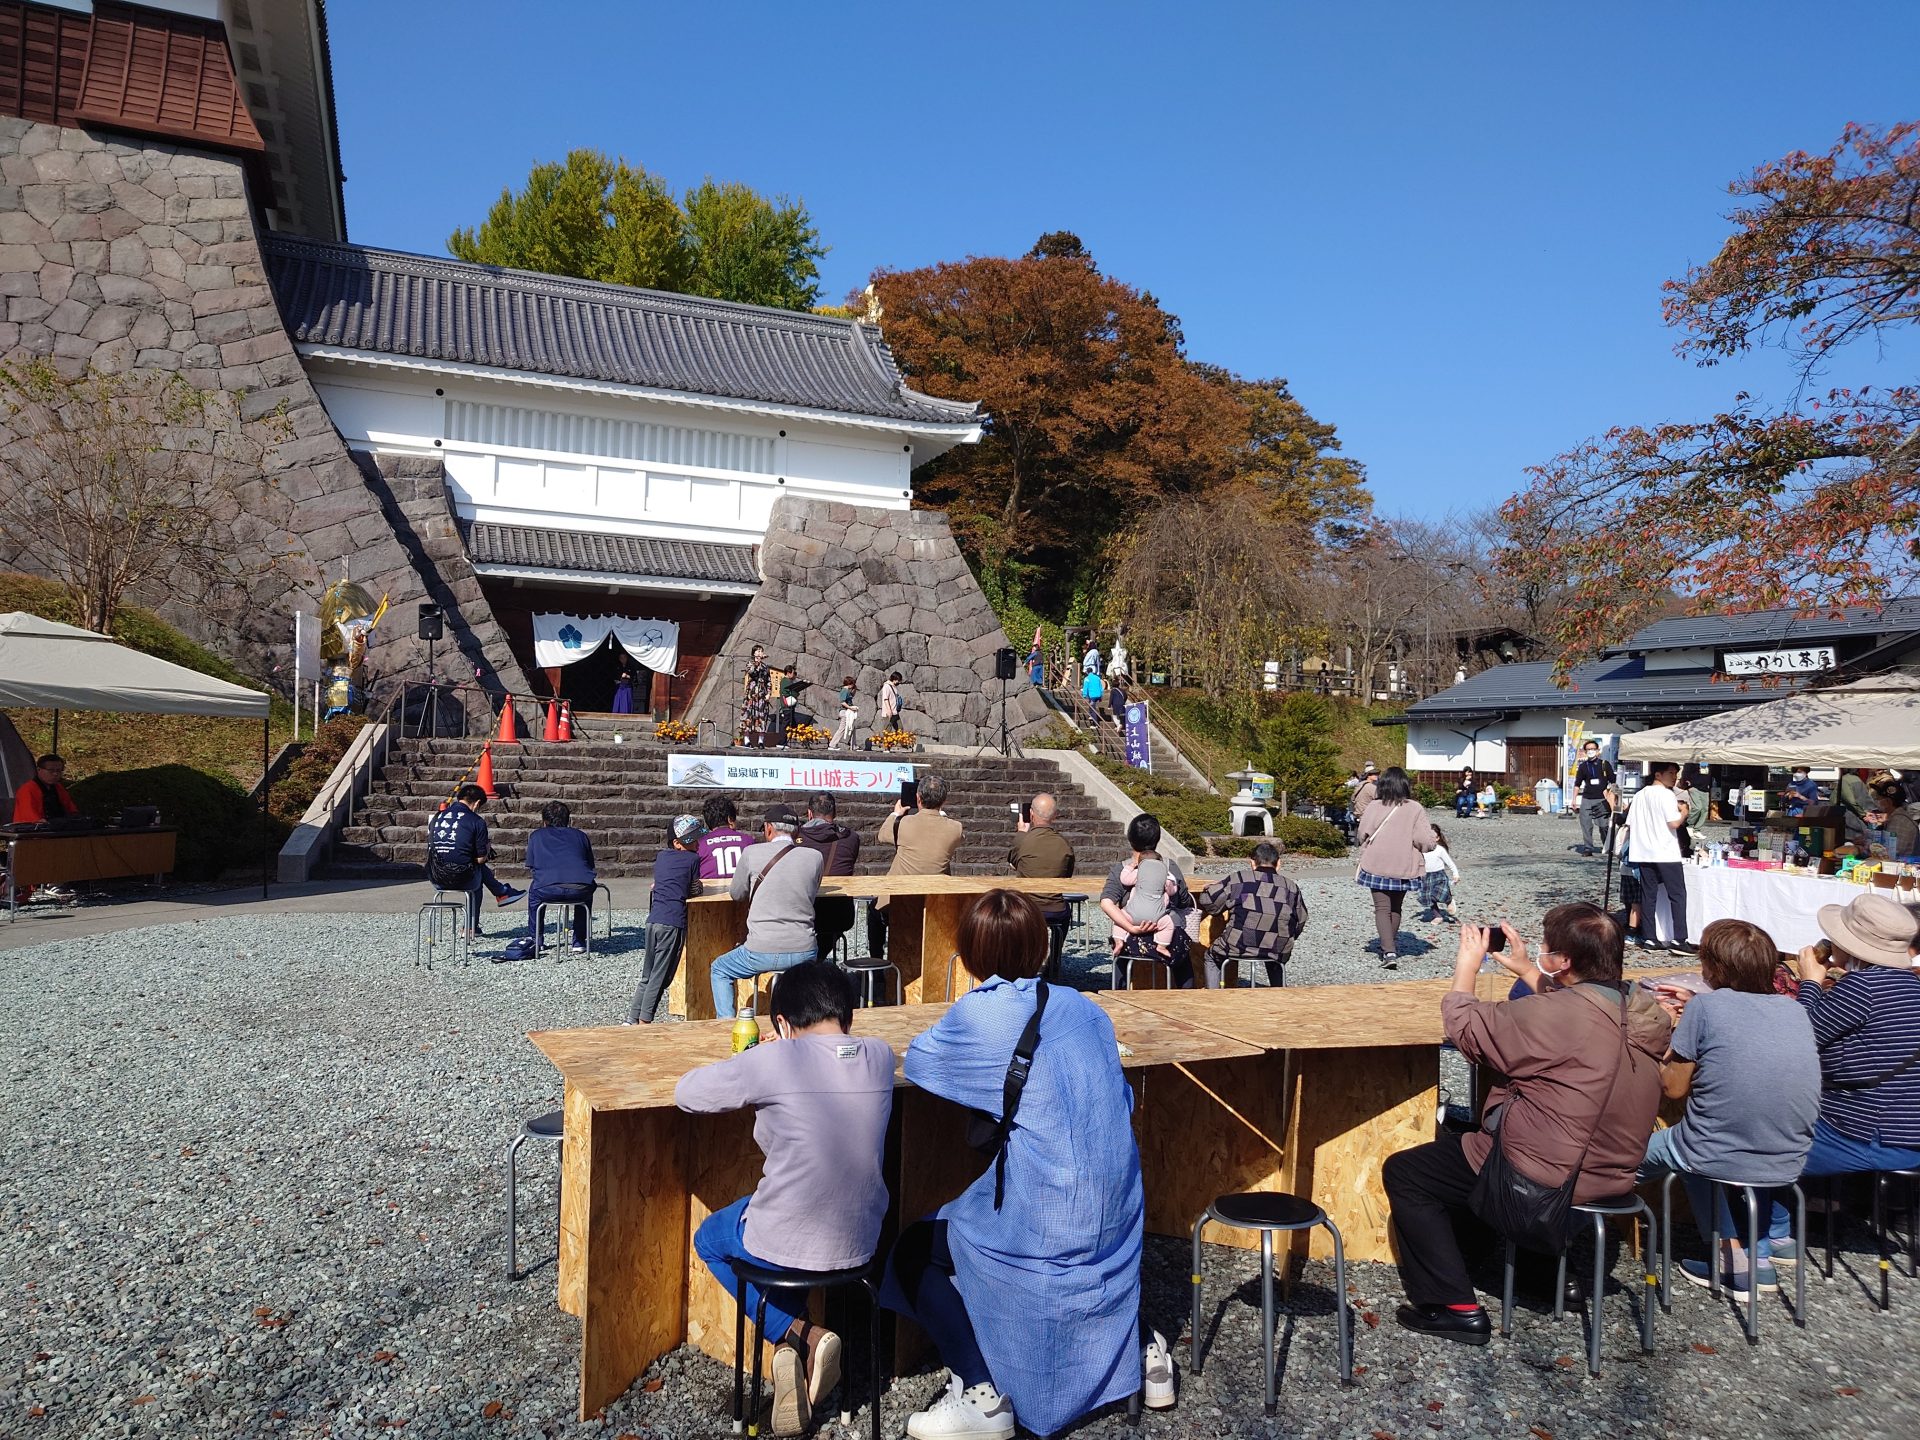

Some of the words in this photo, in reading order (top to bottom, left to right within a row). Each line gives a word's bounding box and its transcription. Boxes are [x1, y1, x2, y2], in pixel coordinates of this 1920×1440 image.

[1755, 650, 1831, 672] かかし茶屋
[1130, 727, 1142, 768] 上山城
[727, 766, 779, 780] 温泉城下町
[784, 767, 893, 789] 上山城まつり
[712, 846, 742, 876] 10
